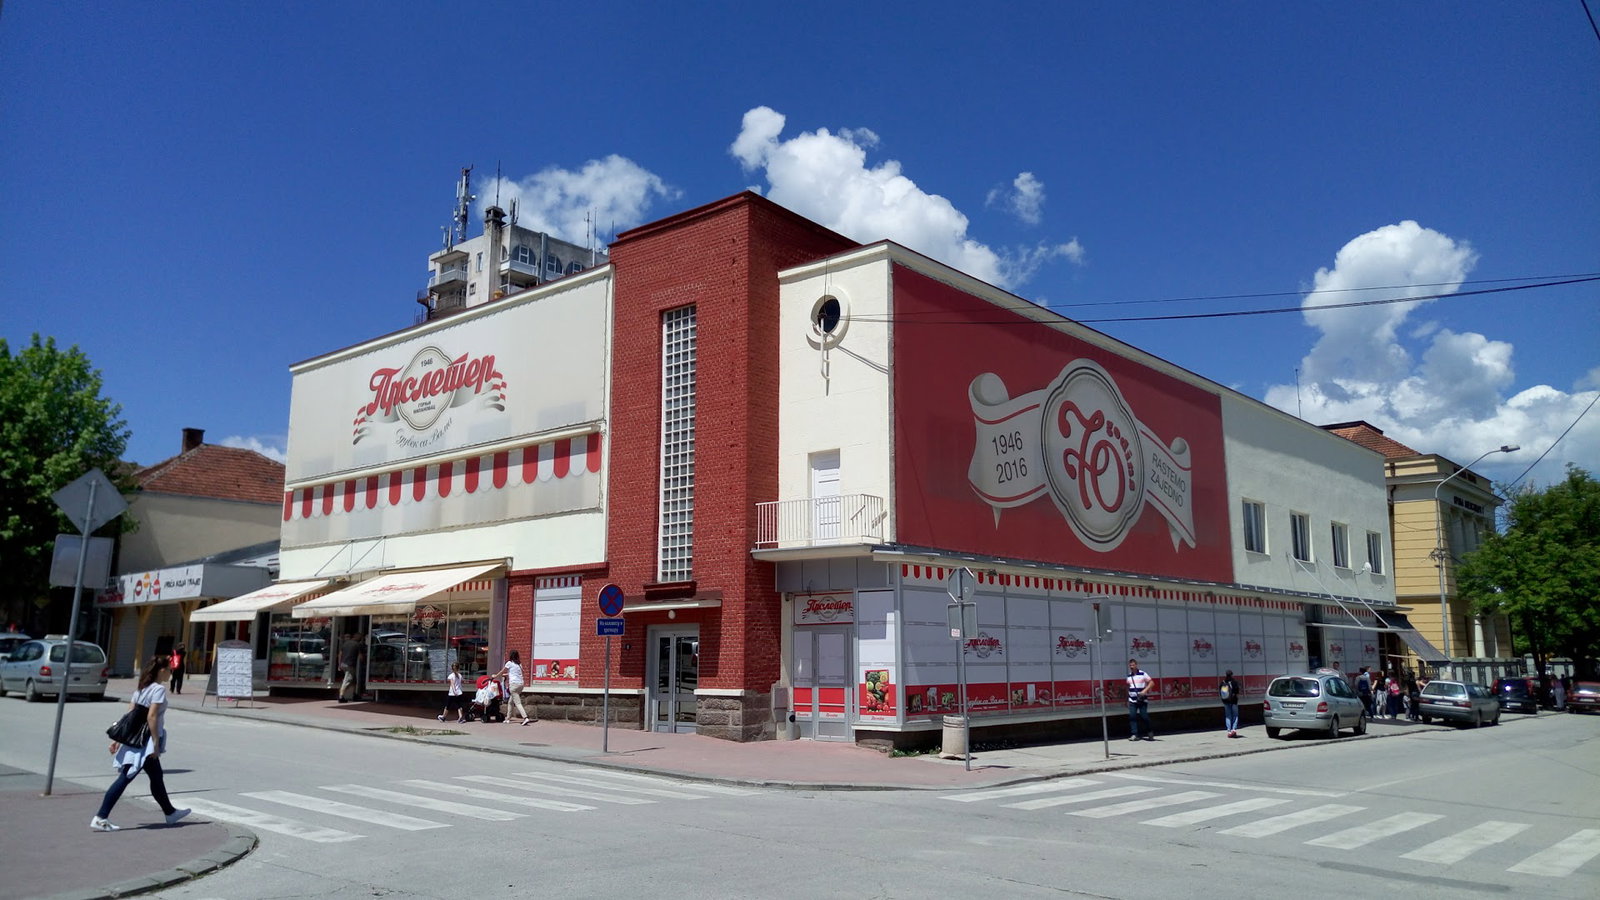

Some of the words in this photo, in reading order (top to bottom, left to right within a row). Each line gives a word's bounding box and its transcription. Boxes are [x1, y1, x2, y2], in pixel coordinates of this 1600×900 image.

[421, 357, 433, 367] 1946
[992, 431, 1023, 456] 1946
[1058, 400, 1125, 513] 70
[1106, 420, 1135, 491] godina
[996, 457, 1027, 484] 2016
[1151, 469, 1183, 507] ZAJEDNO
[1152, 452, 1185, 493] RASTEMO
